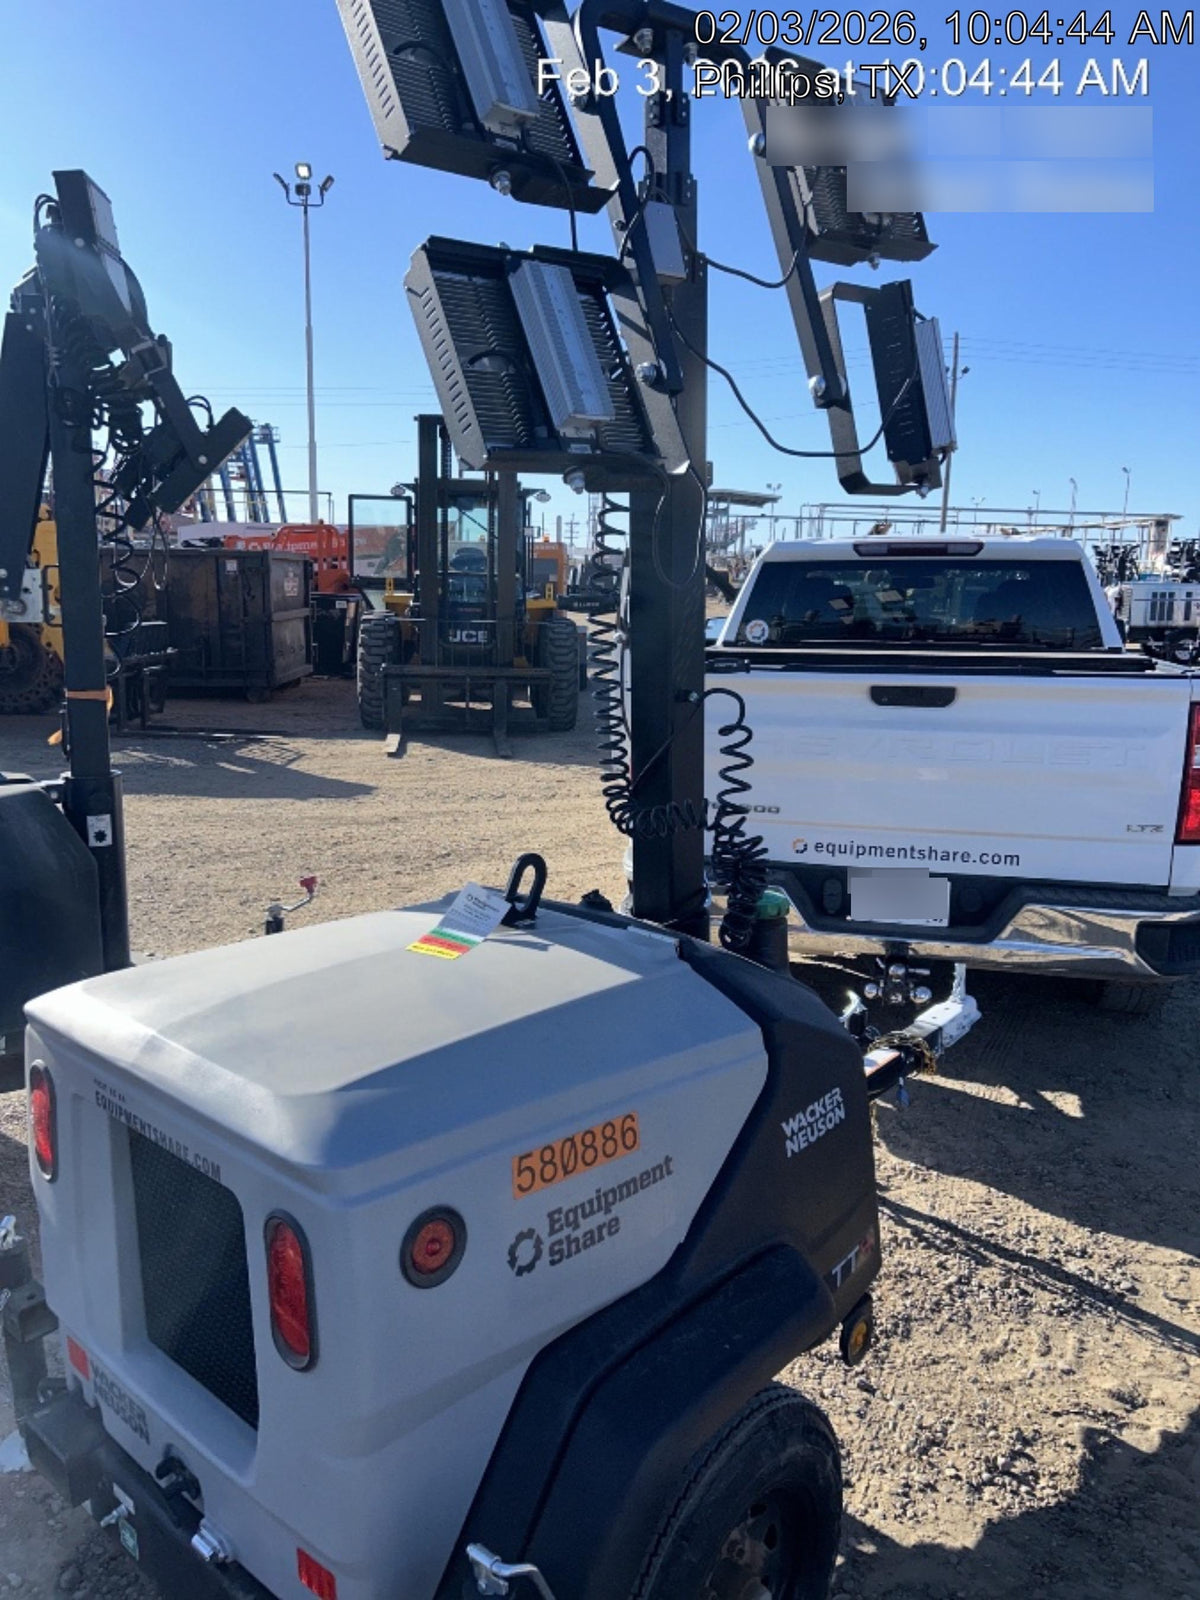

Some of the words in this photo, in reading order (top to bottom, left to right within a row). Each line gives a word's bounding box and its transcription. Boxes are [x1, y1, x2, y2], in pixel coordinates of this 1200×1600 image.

[813, 839, 1021, 867] equipmentshare.com
[95, 1090, 221, 1182] EQUIPMENTSHARE.COM
[780, 1087, 844, 1138] WACKER
[785, 1103, 846, 1159] NEUSON
[515, 1113, 639, 1194] 580886
[546, 1154, 674, 1238] Equipment
[548, 1215, 621, 1267] Share
